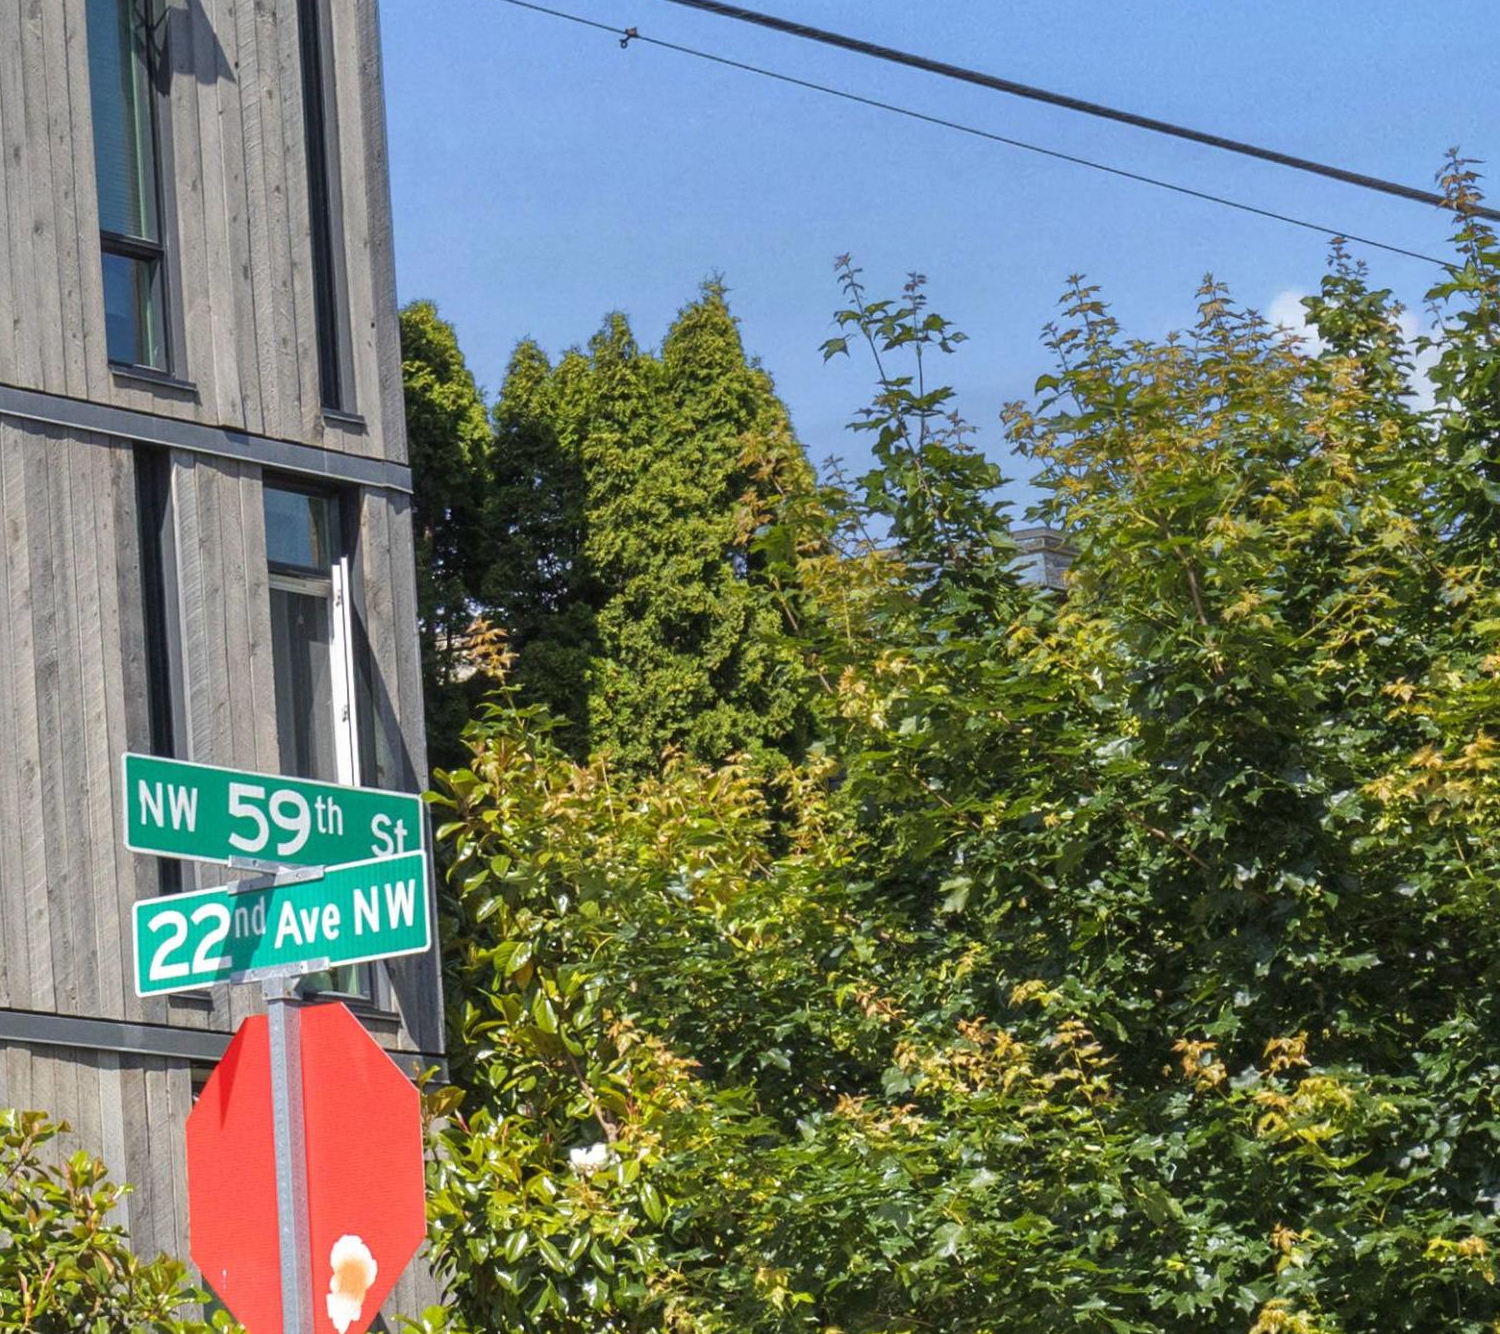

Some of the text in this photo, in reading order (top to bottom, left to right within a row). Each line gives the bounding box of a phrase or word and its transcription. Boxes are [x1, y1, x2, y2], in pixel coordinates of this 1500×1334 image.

[138, 779, 408, 857] NW 59th St
[147, 878, 416, 981] 22nd Ave NW
